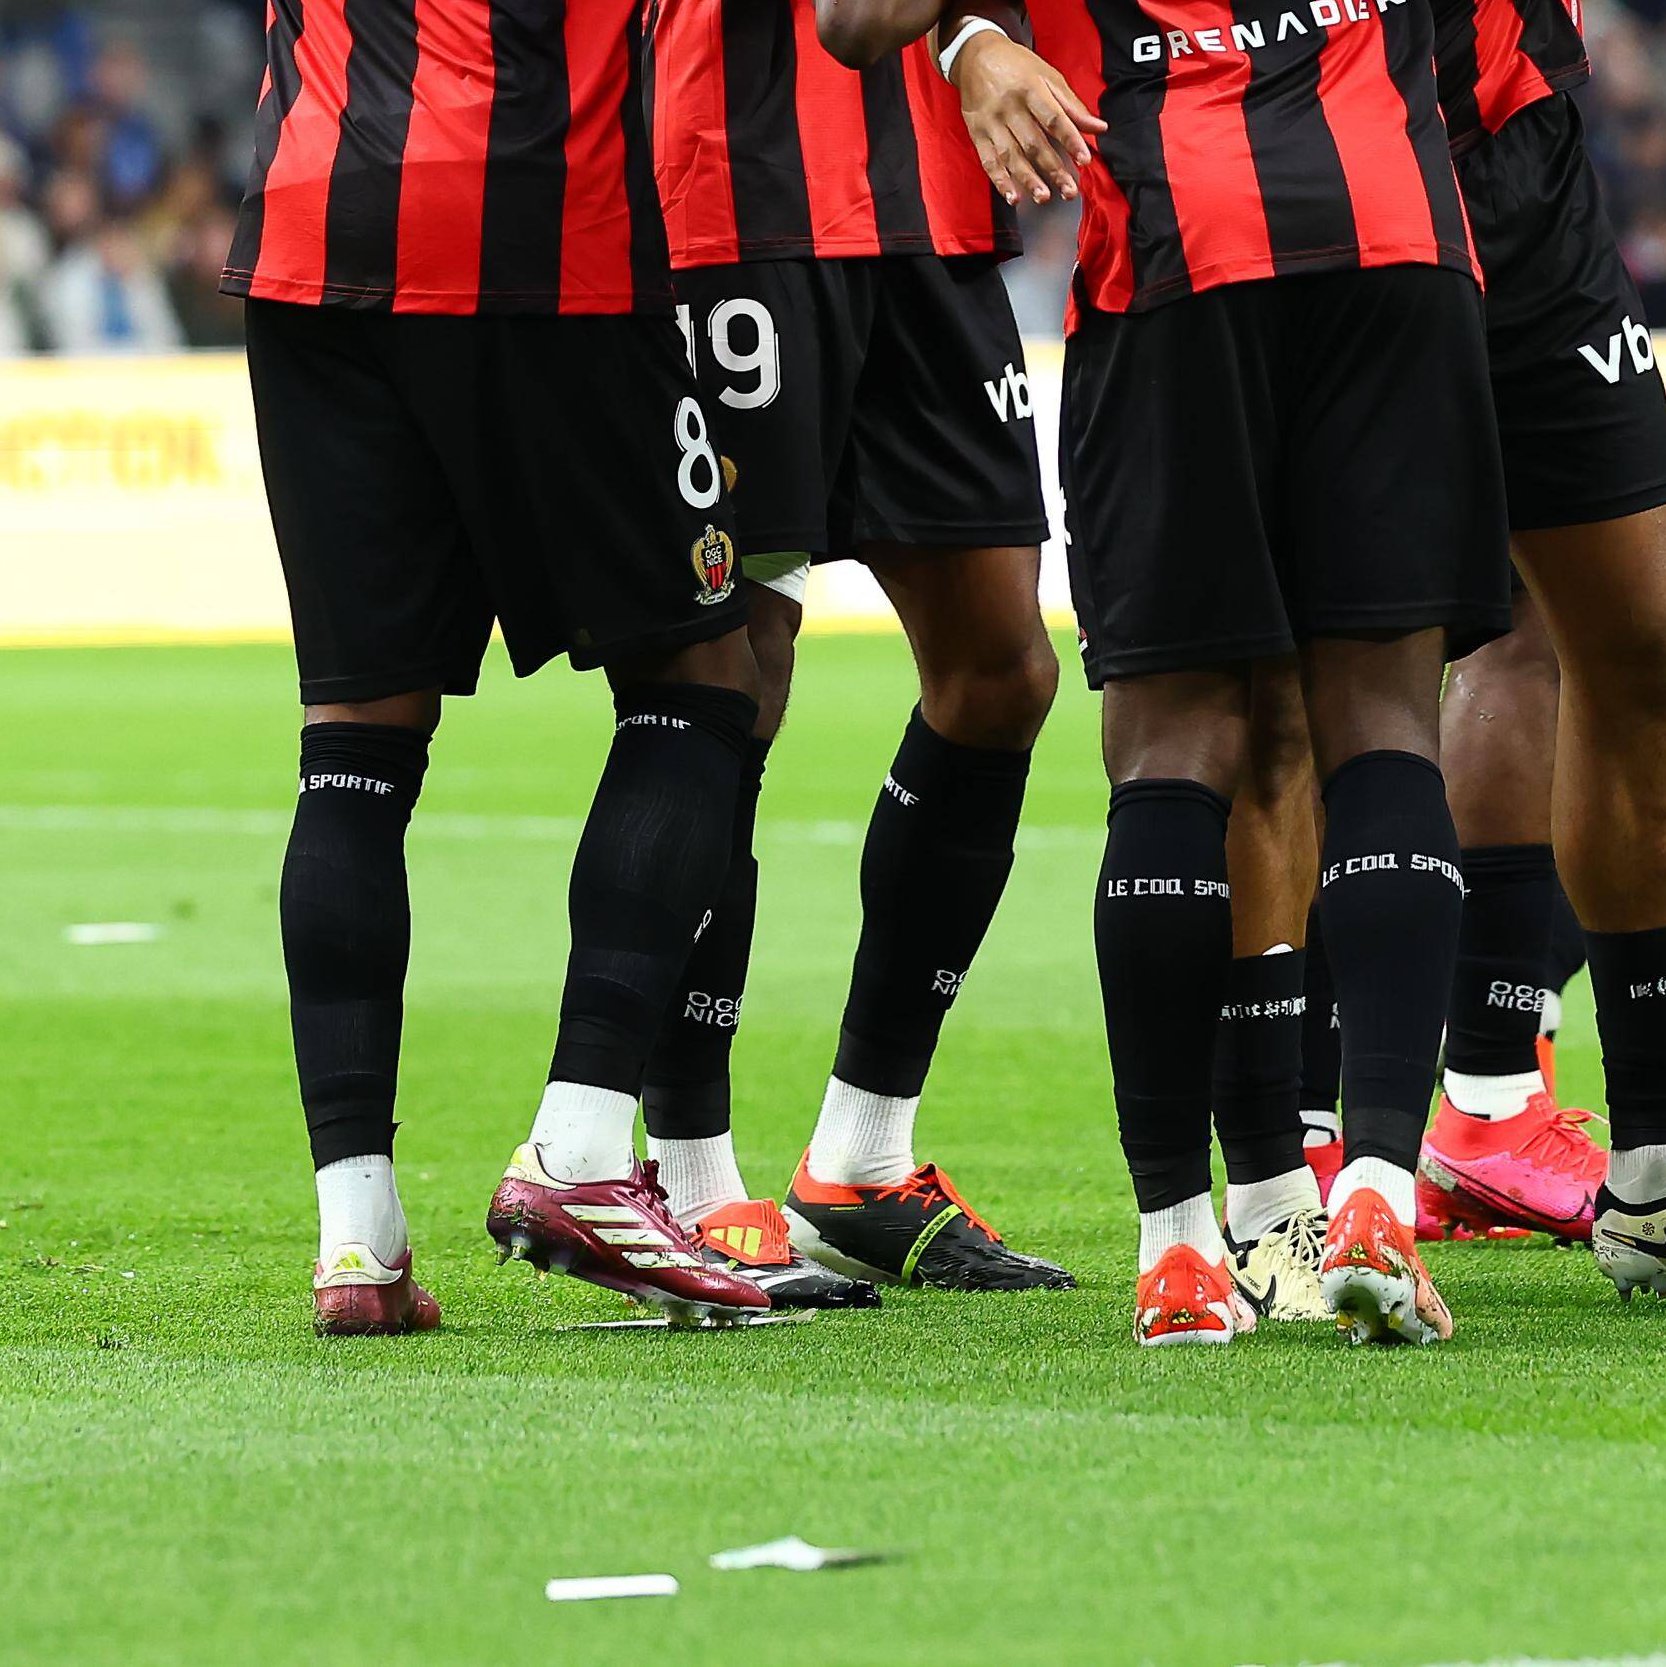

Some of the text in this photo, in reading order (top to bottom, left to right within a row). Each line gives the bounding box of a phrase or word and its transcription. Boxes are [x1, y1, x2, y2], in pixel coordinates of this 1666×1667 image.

[674, 397, 721, 509] 8
[705, 545, 722, 559] OGC
[309, 774, 395, 795] SPORTIF
[1322, 862, 1341, 888] LE
[1345, 853, 1399, 875] COQ
[1107, 878, 1129, 898] LE
[1133, 878, 1184, 896] COQ
[1486, 992, 1544, 1013] NICE
